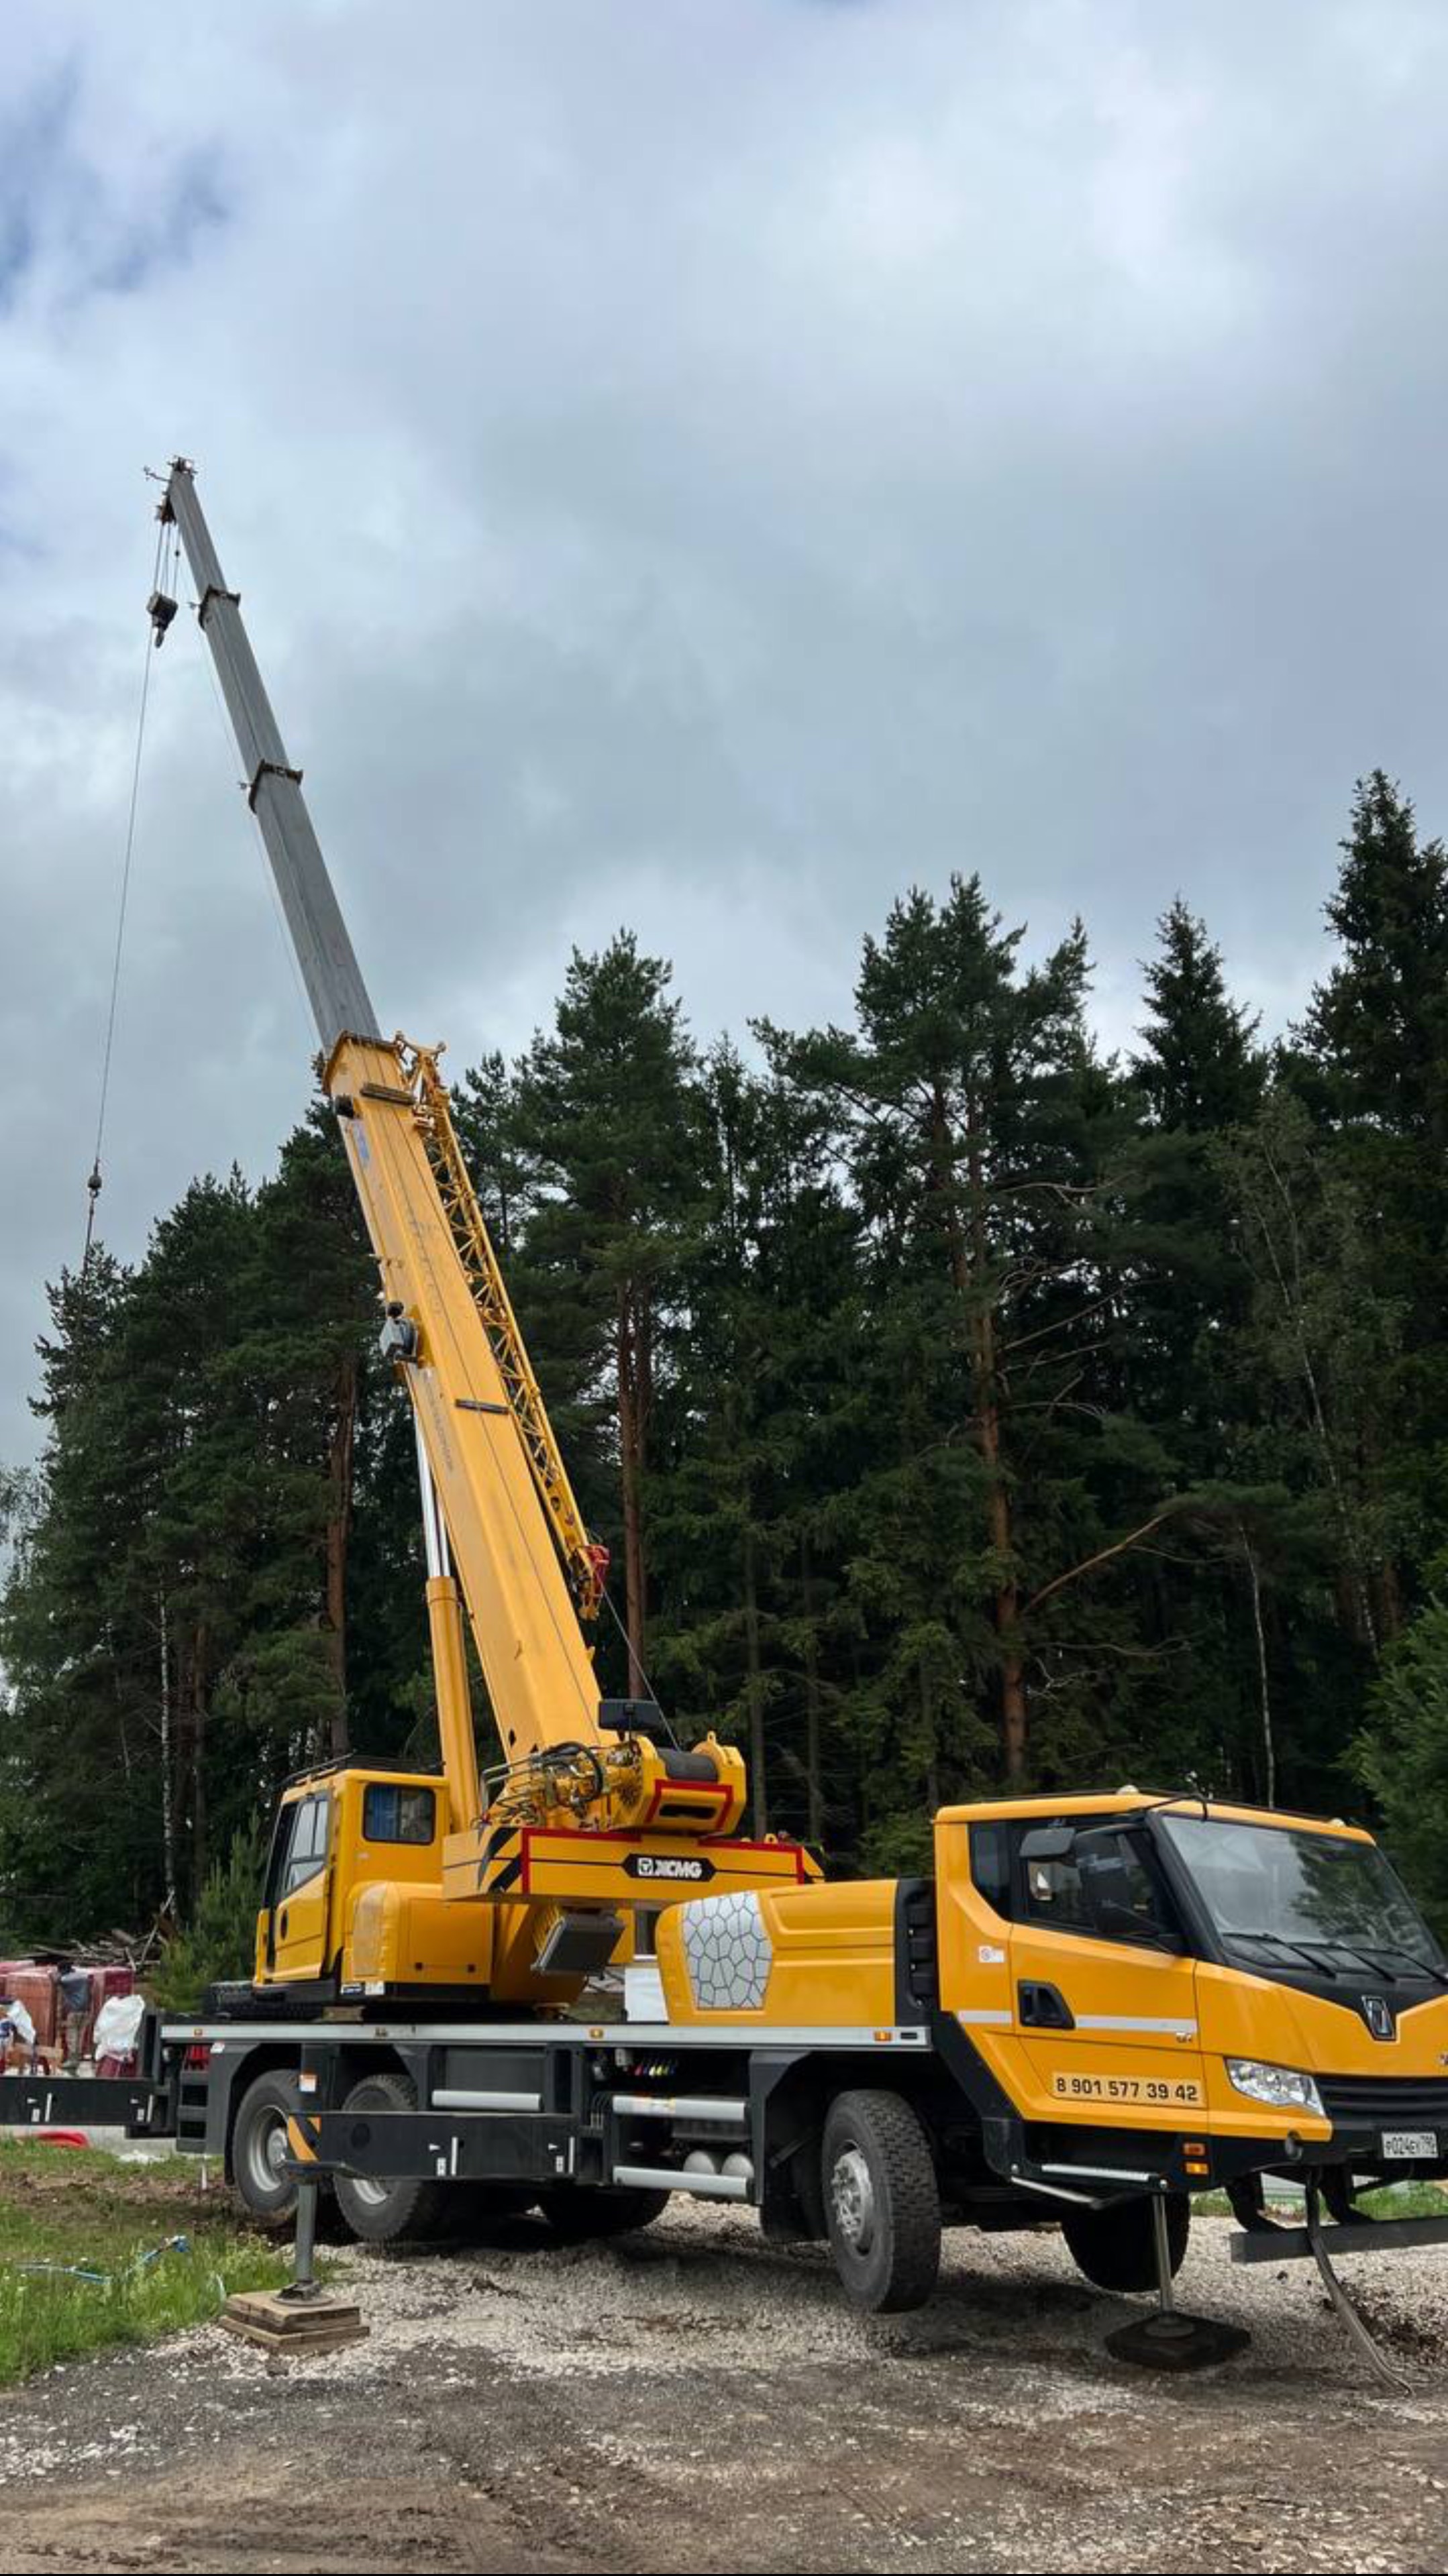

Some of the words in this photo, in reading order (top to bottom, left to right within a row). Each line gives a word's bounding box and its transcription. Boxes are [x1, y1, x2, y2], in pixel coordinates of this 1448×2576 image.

[655, 1859, 703, 1878] XCMG
[1057, 2078, 1067, 2092] 8
[1072, 2079, 1102, 2095] 901
[1108, 2081, 1139, 2098] 577
[1146, 2083, 1169, 2099] 39
[1176, 2085, 1198, 2102] 42
